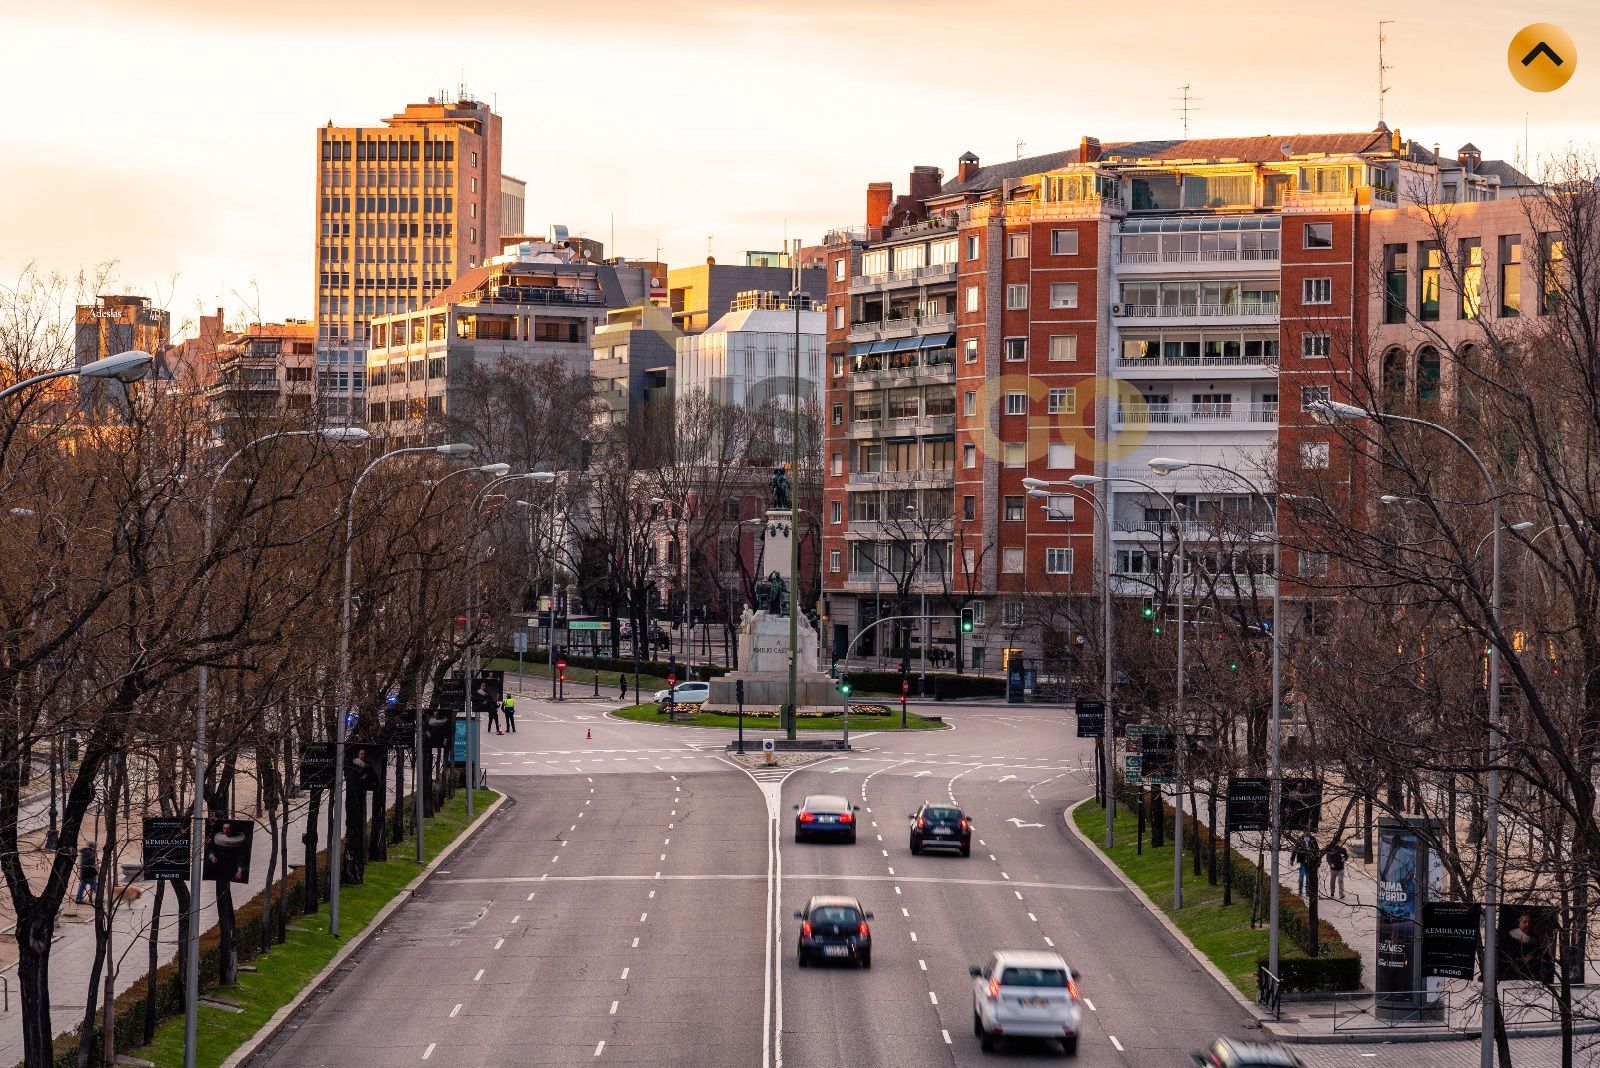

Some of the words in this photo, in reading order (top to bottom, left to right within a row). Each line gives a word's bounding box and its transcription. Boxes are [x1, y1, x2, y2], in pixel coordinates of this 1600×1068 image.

[89, 308, 122, 318] Adeslas
[1379, 881, 1403, 892] PUMA
[1425, 928, 1477, 936] REMBRANDT
